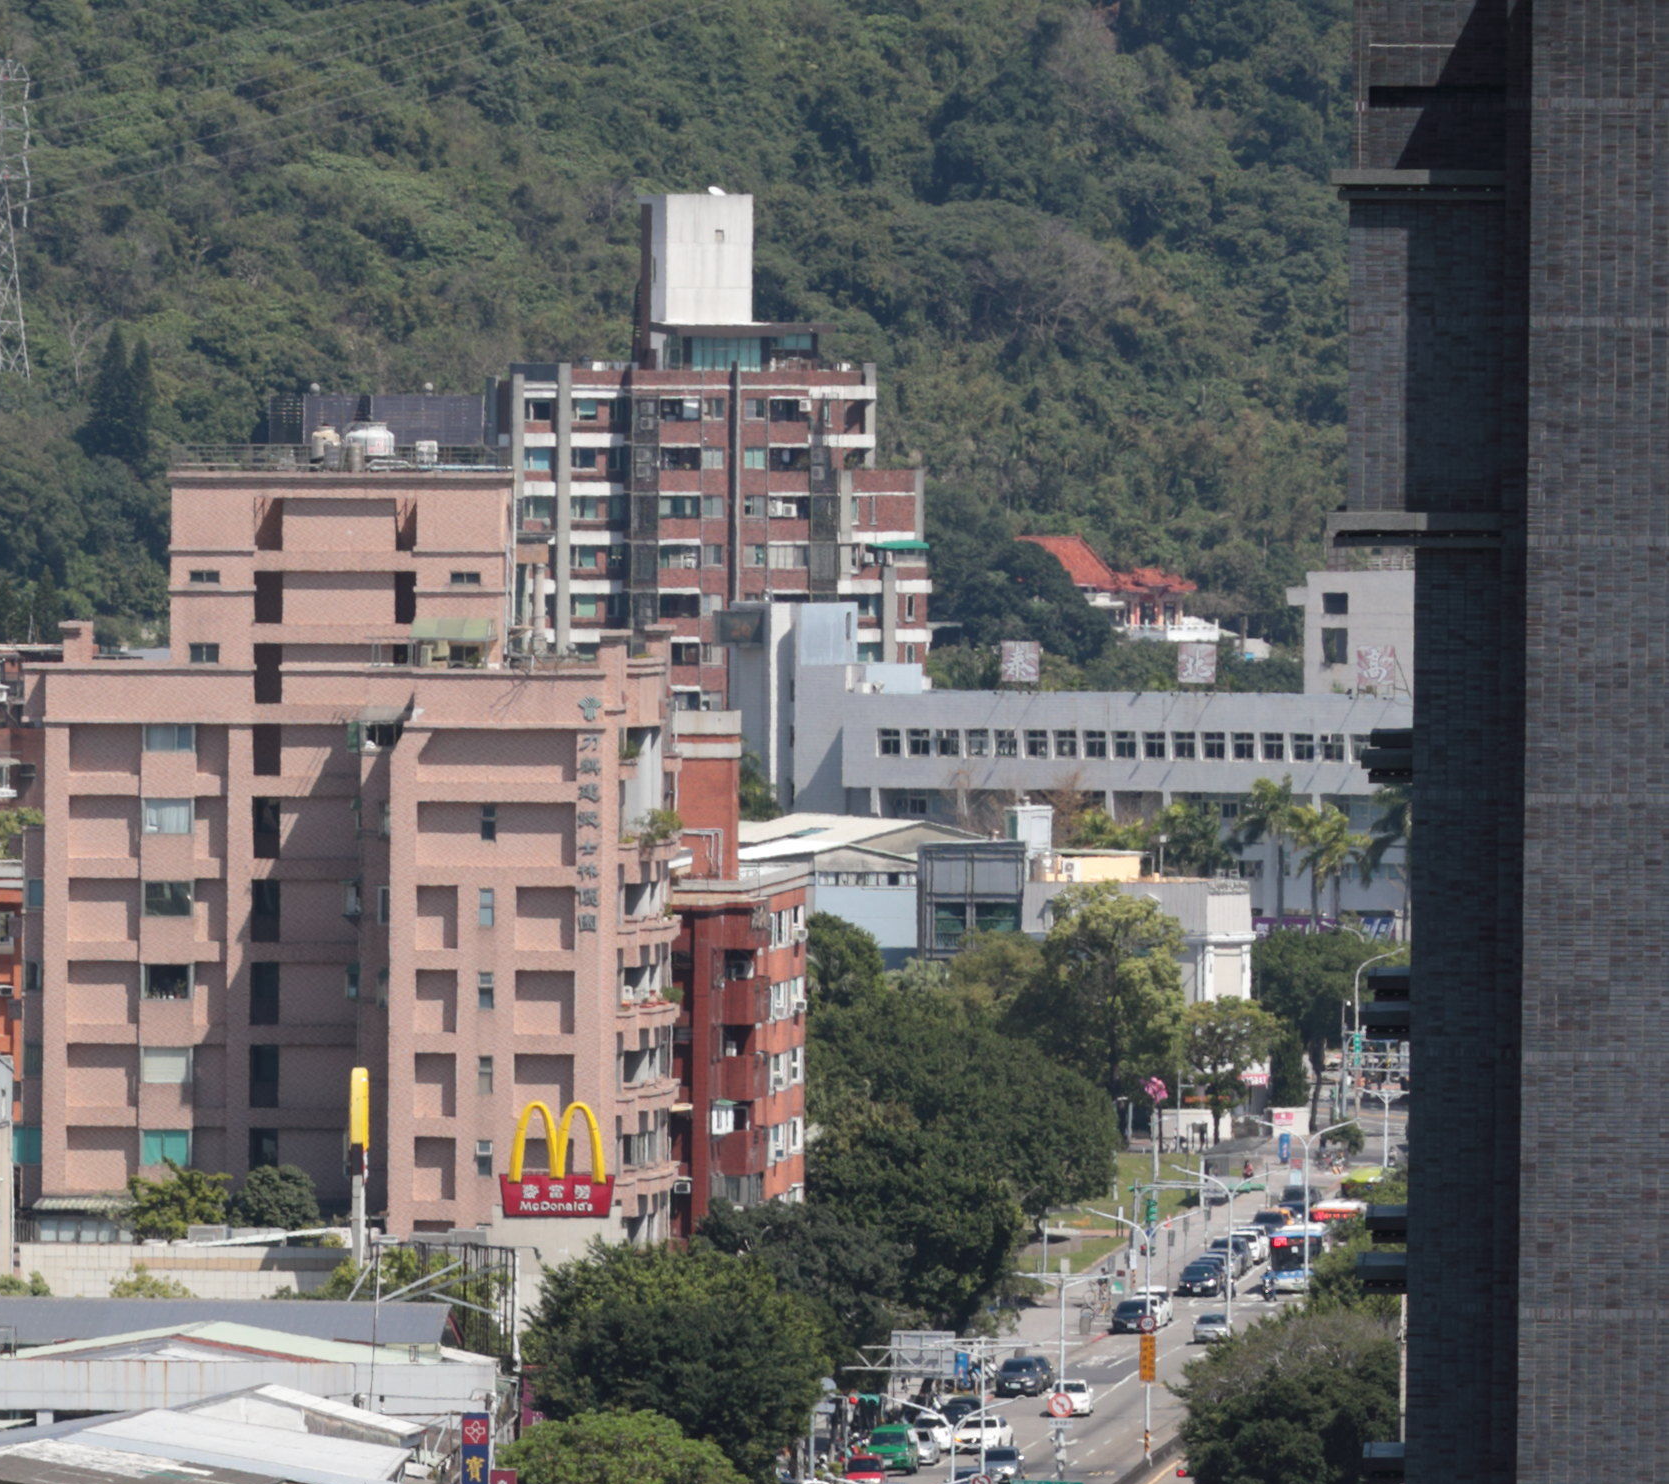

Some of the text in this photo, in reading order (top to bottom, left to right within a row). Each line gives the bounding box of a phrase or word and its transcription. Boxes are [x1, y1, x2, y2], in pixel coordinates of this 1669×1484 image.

[1183, 651, 1212, 677] 北
[522, 1184, 591, 1199] 麥當勞
[519, 1200, 594, 1212] McDonald's
